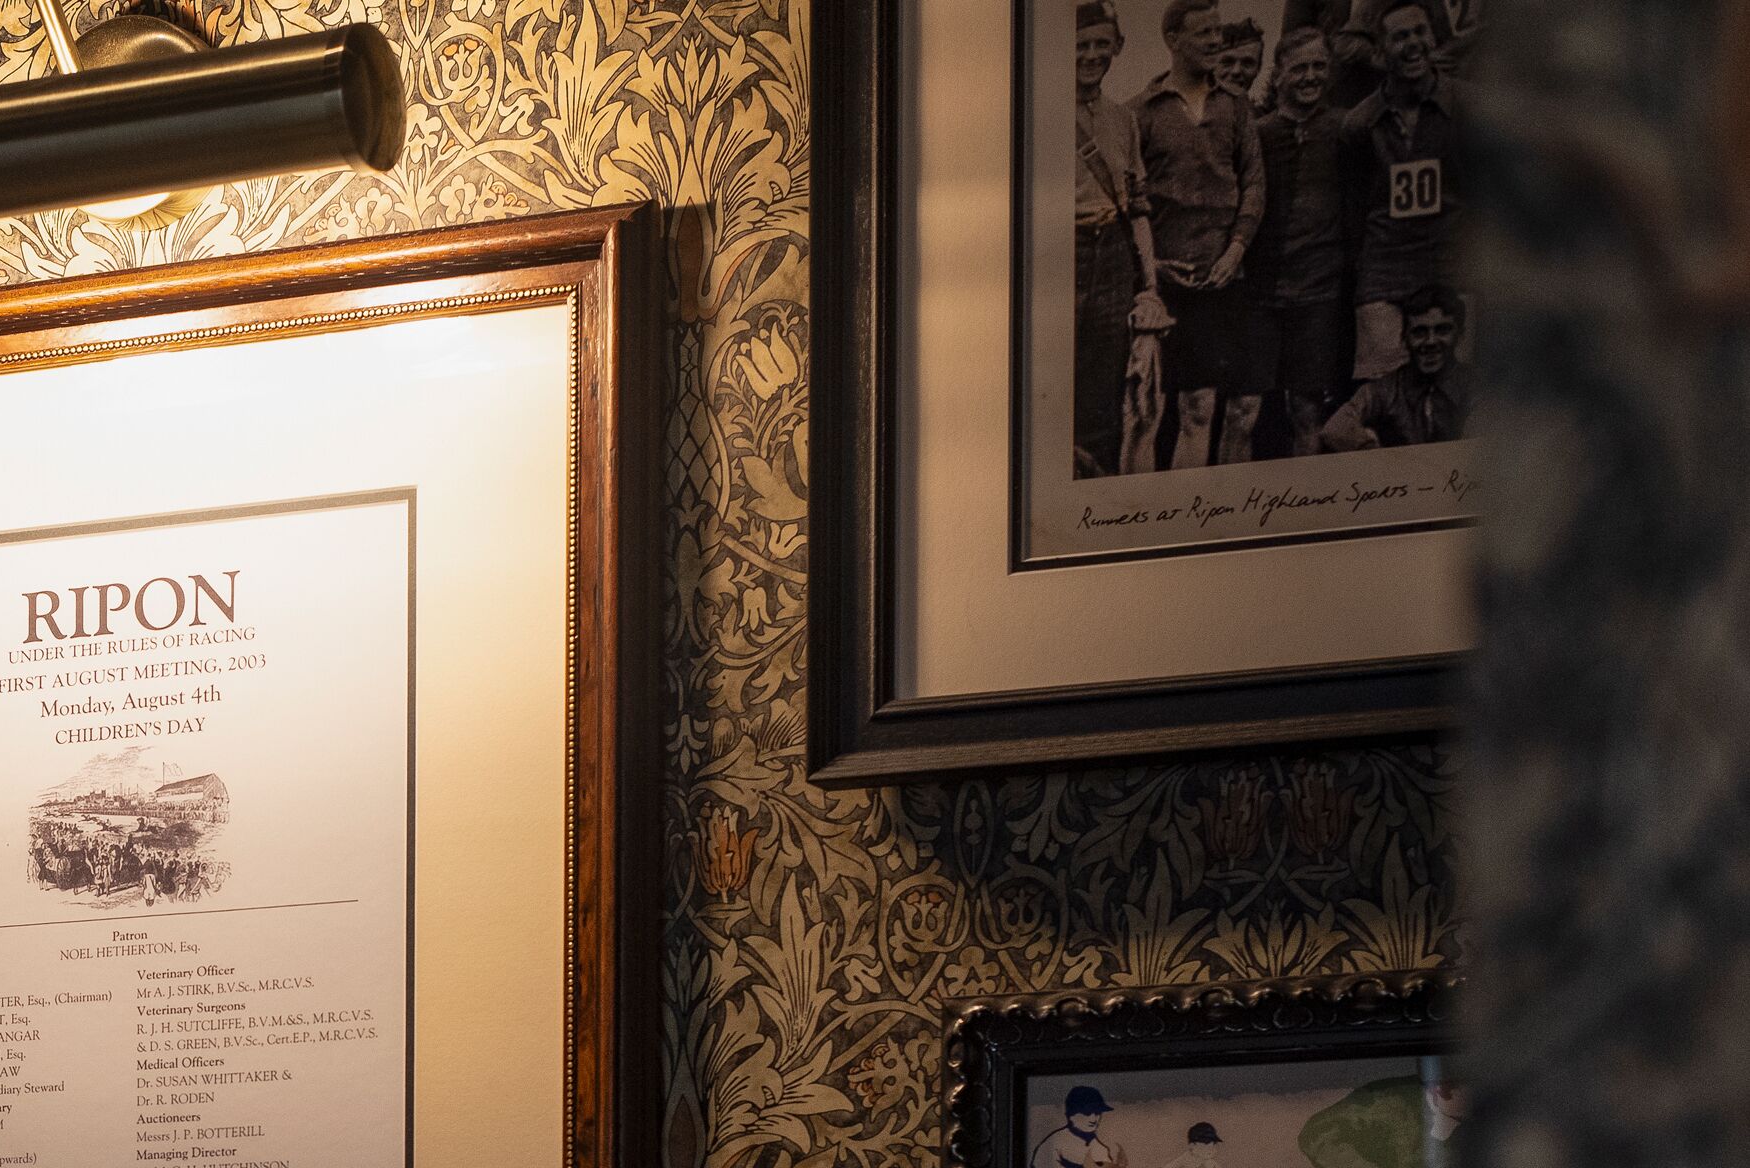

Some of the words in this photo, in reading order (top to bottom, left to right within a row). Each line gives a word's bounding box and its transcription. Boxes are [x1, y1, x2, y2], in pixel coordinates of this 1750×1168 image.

[1394, 167, 1437, 211] 30
[1186, 495, 1235, 527] Ripon
[1242, 486, 1339, 527] Highland
[21, 569, 240, 644] RIPON
[8, 646, 64, 663] UNDER
[69, 642, 102, 657] THE
[107, 637, 157, 654] RULES
[162, 634, 183, 648] OF
[189, 627, 255, 645] RACING
[52, 666, 128, 687] AUGUST
[134, 659, 221, 679] MEETING,
[228, 654, 265, 670] 2003
[40, 696, 114, 717] Monday,
[122, 691, 183, 711] August
[191, 684, 220, 704] 4th
[55, 721, 161, 744] CHILDREN'S
[167, 717, 205, 734] DAY
[112, 930, 147, 941] Patron
[60, 947, 93, 960] NOEL
[96, 941, 176, 957] HETHERTON,
[180, 941, 200, 954] Esq.
[136, 968, 193, 980] Veterinary
[196, 964, 235, 976] Officer
[27, 994, 50, 1007] Esq.,
[54, 990, 112, 1005] (Chairman)
[136, 1004, 193, 1016] Veterinary
[196, 1002, 245, 1014] Surgeons
[136, 1057, 178, 1070] Medical
[181, 1055, 224, 1068] Officers
[24, 1080, 64, 1093] Steward
[136, 1077, 152, 1088] Dr.
[155, 1074, 197, 1087] SUSAN
[200, 1070, 278, 1084] WHITTAKER
[281, 1069, 292, 1080] &
[136, 1112, 200, 1124] Auctioneers
[136, 1148, 188, 1161] Managing
[191, 1146, 237, 1158] Director
